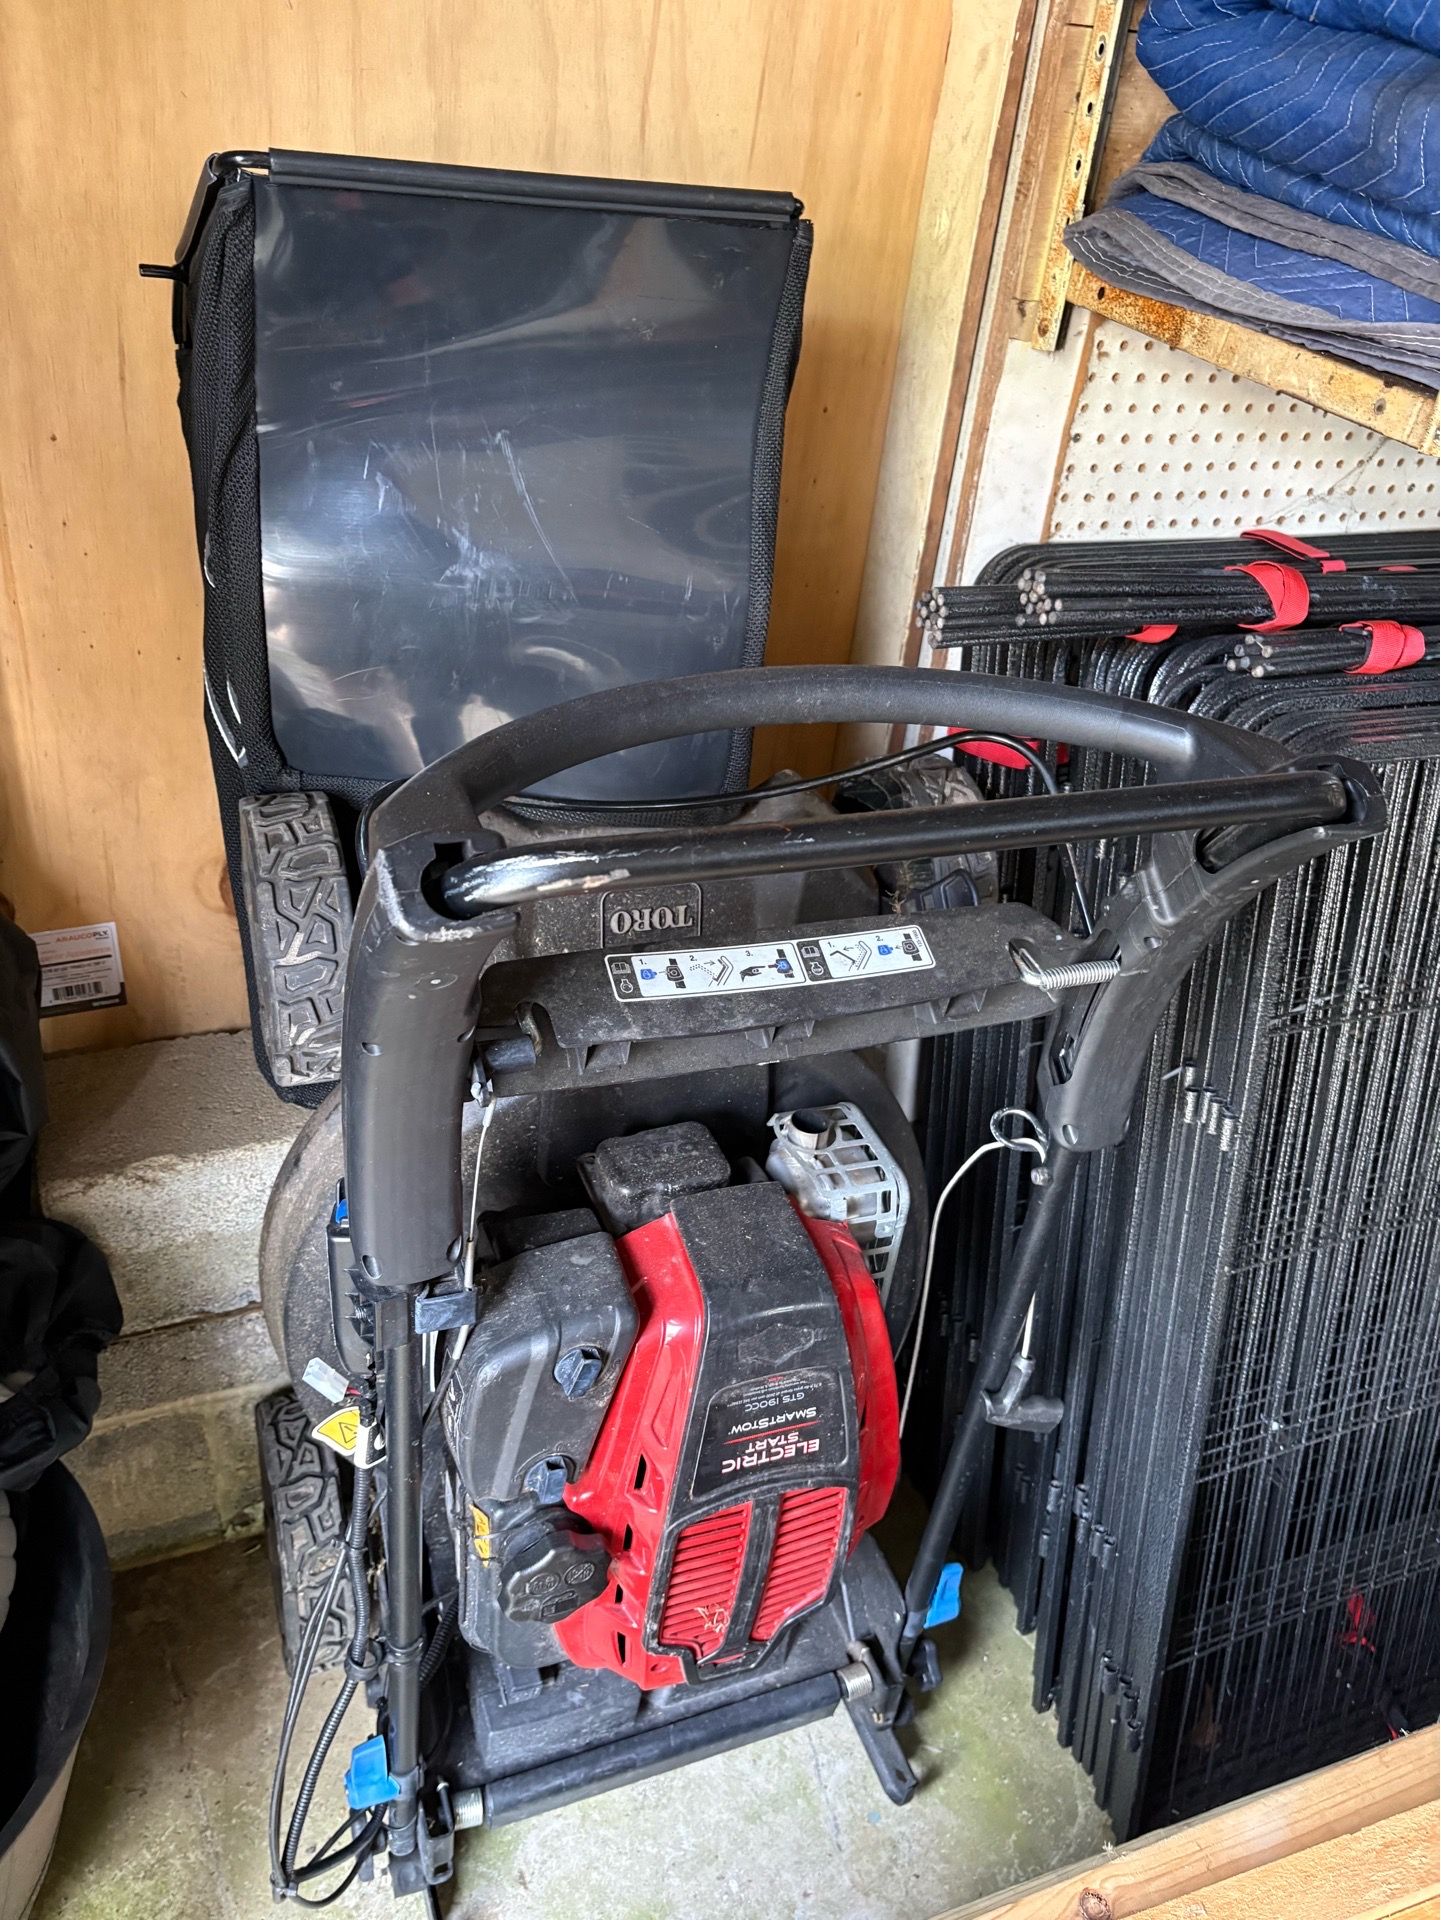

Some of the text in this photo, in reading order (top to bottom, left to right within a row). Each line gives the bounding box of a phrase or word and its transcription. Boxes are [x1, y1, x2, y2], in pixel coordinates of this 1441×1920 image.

[610, 905, 693, 934] TORO
[689, 954, 698, 962] 2.
[744, 1398, 780, 1412] 190CC
[782, 1392, 805, 1404] GTS
[745, 1432, 799, 1454] START
[721, 1438, 820, 1474] ELECTRIC
